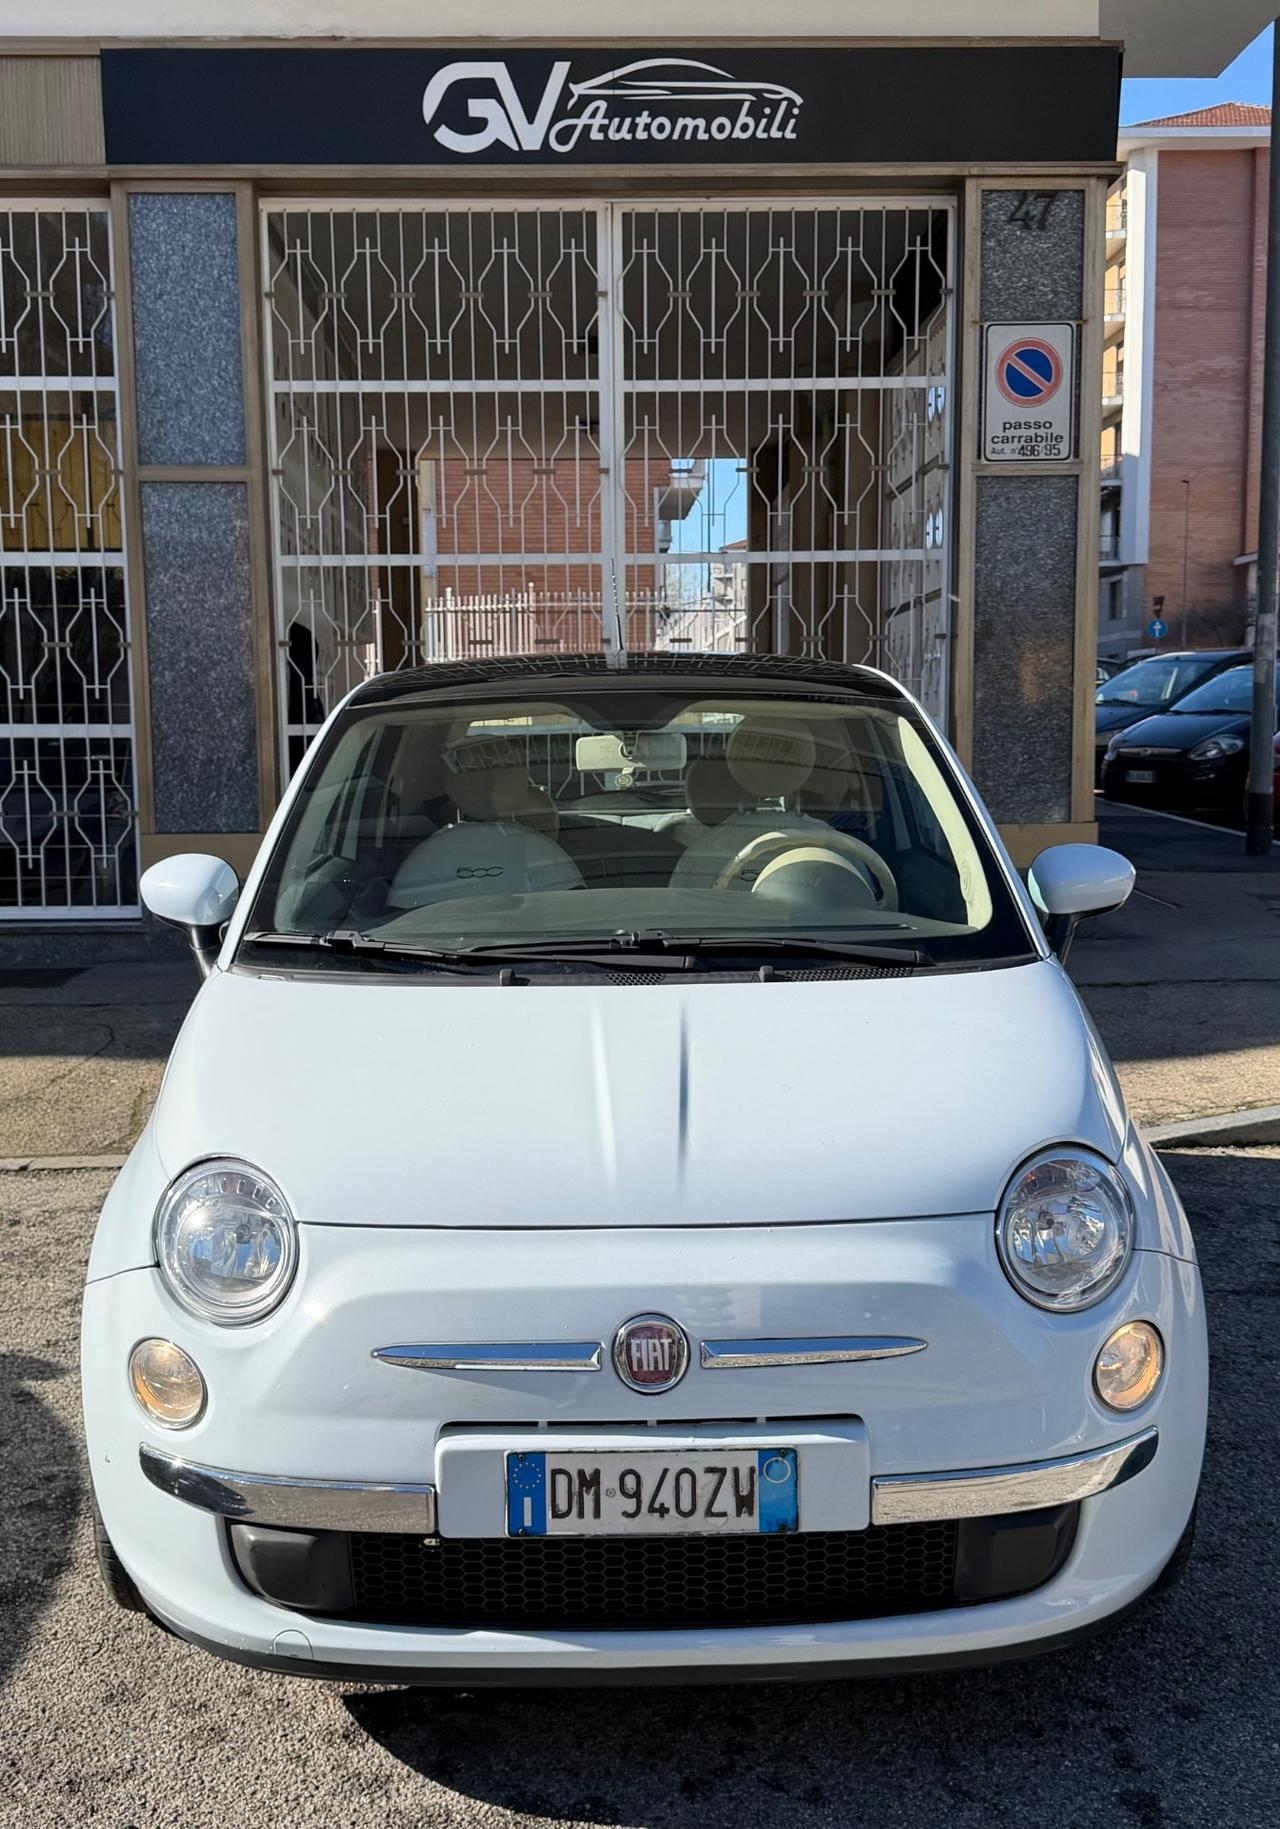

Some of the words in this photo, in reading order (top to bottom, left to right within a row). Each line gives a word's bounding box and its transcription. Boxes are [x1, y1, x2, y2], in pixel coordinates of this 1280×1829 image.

[422, 61, 572, 154] GV
[548, 98, 801, 153] Automobili
[1007, 190, 1058, 231] 47
[991, 432, 1064, 445] carrabile
[1002, 420, 1053, 433] passo
[630, 1338, 673, 1373] FIAT
